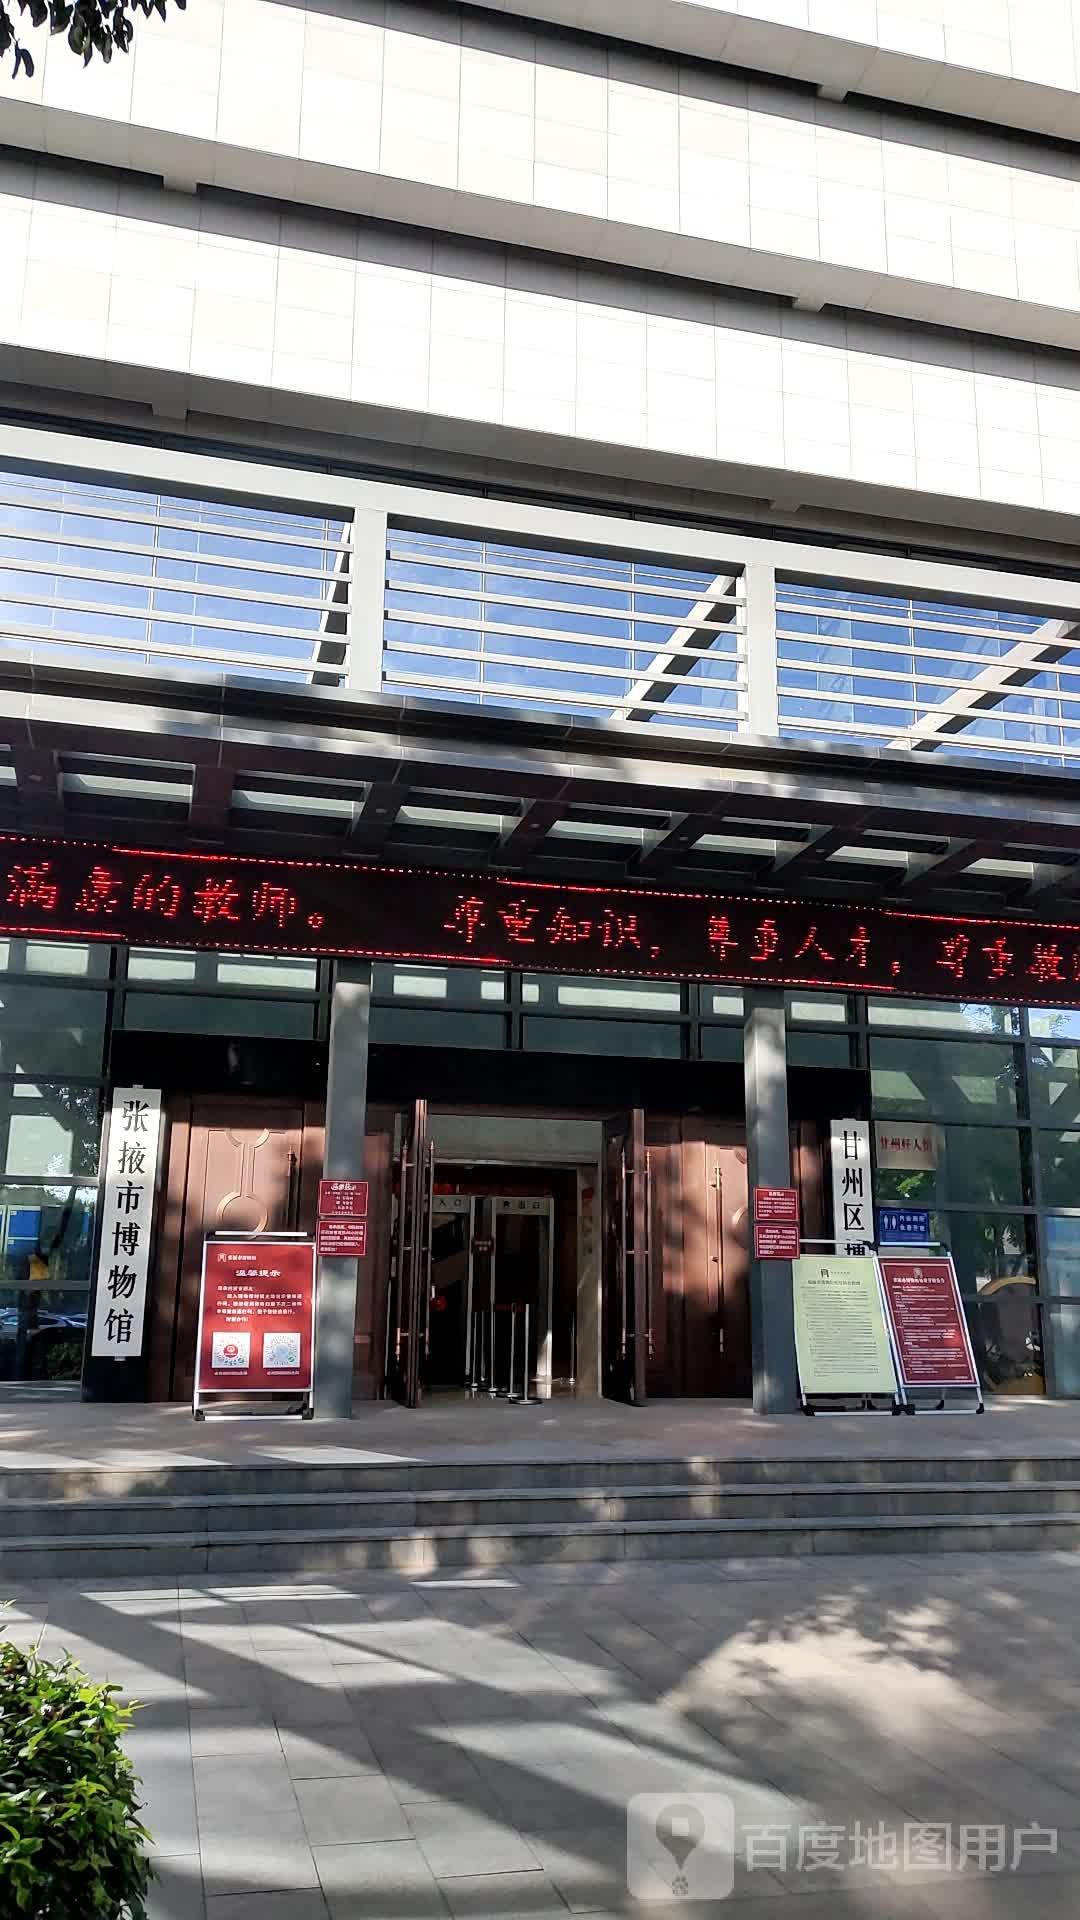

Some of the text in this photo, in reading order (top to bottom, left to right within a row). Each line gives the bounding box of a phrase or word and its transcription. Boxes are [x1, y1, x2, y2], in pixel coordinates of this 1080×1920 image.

[104, 1100, 149, 1344] 张掖市博物馆
